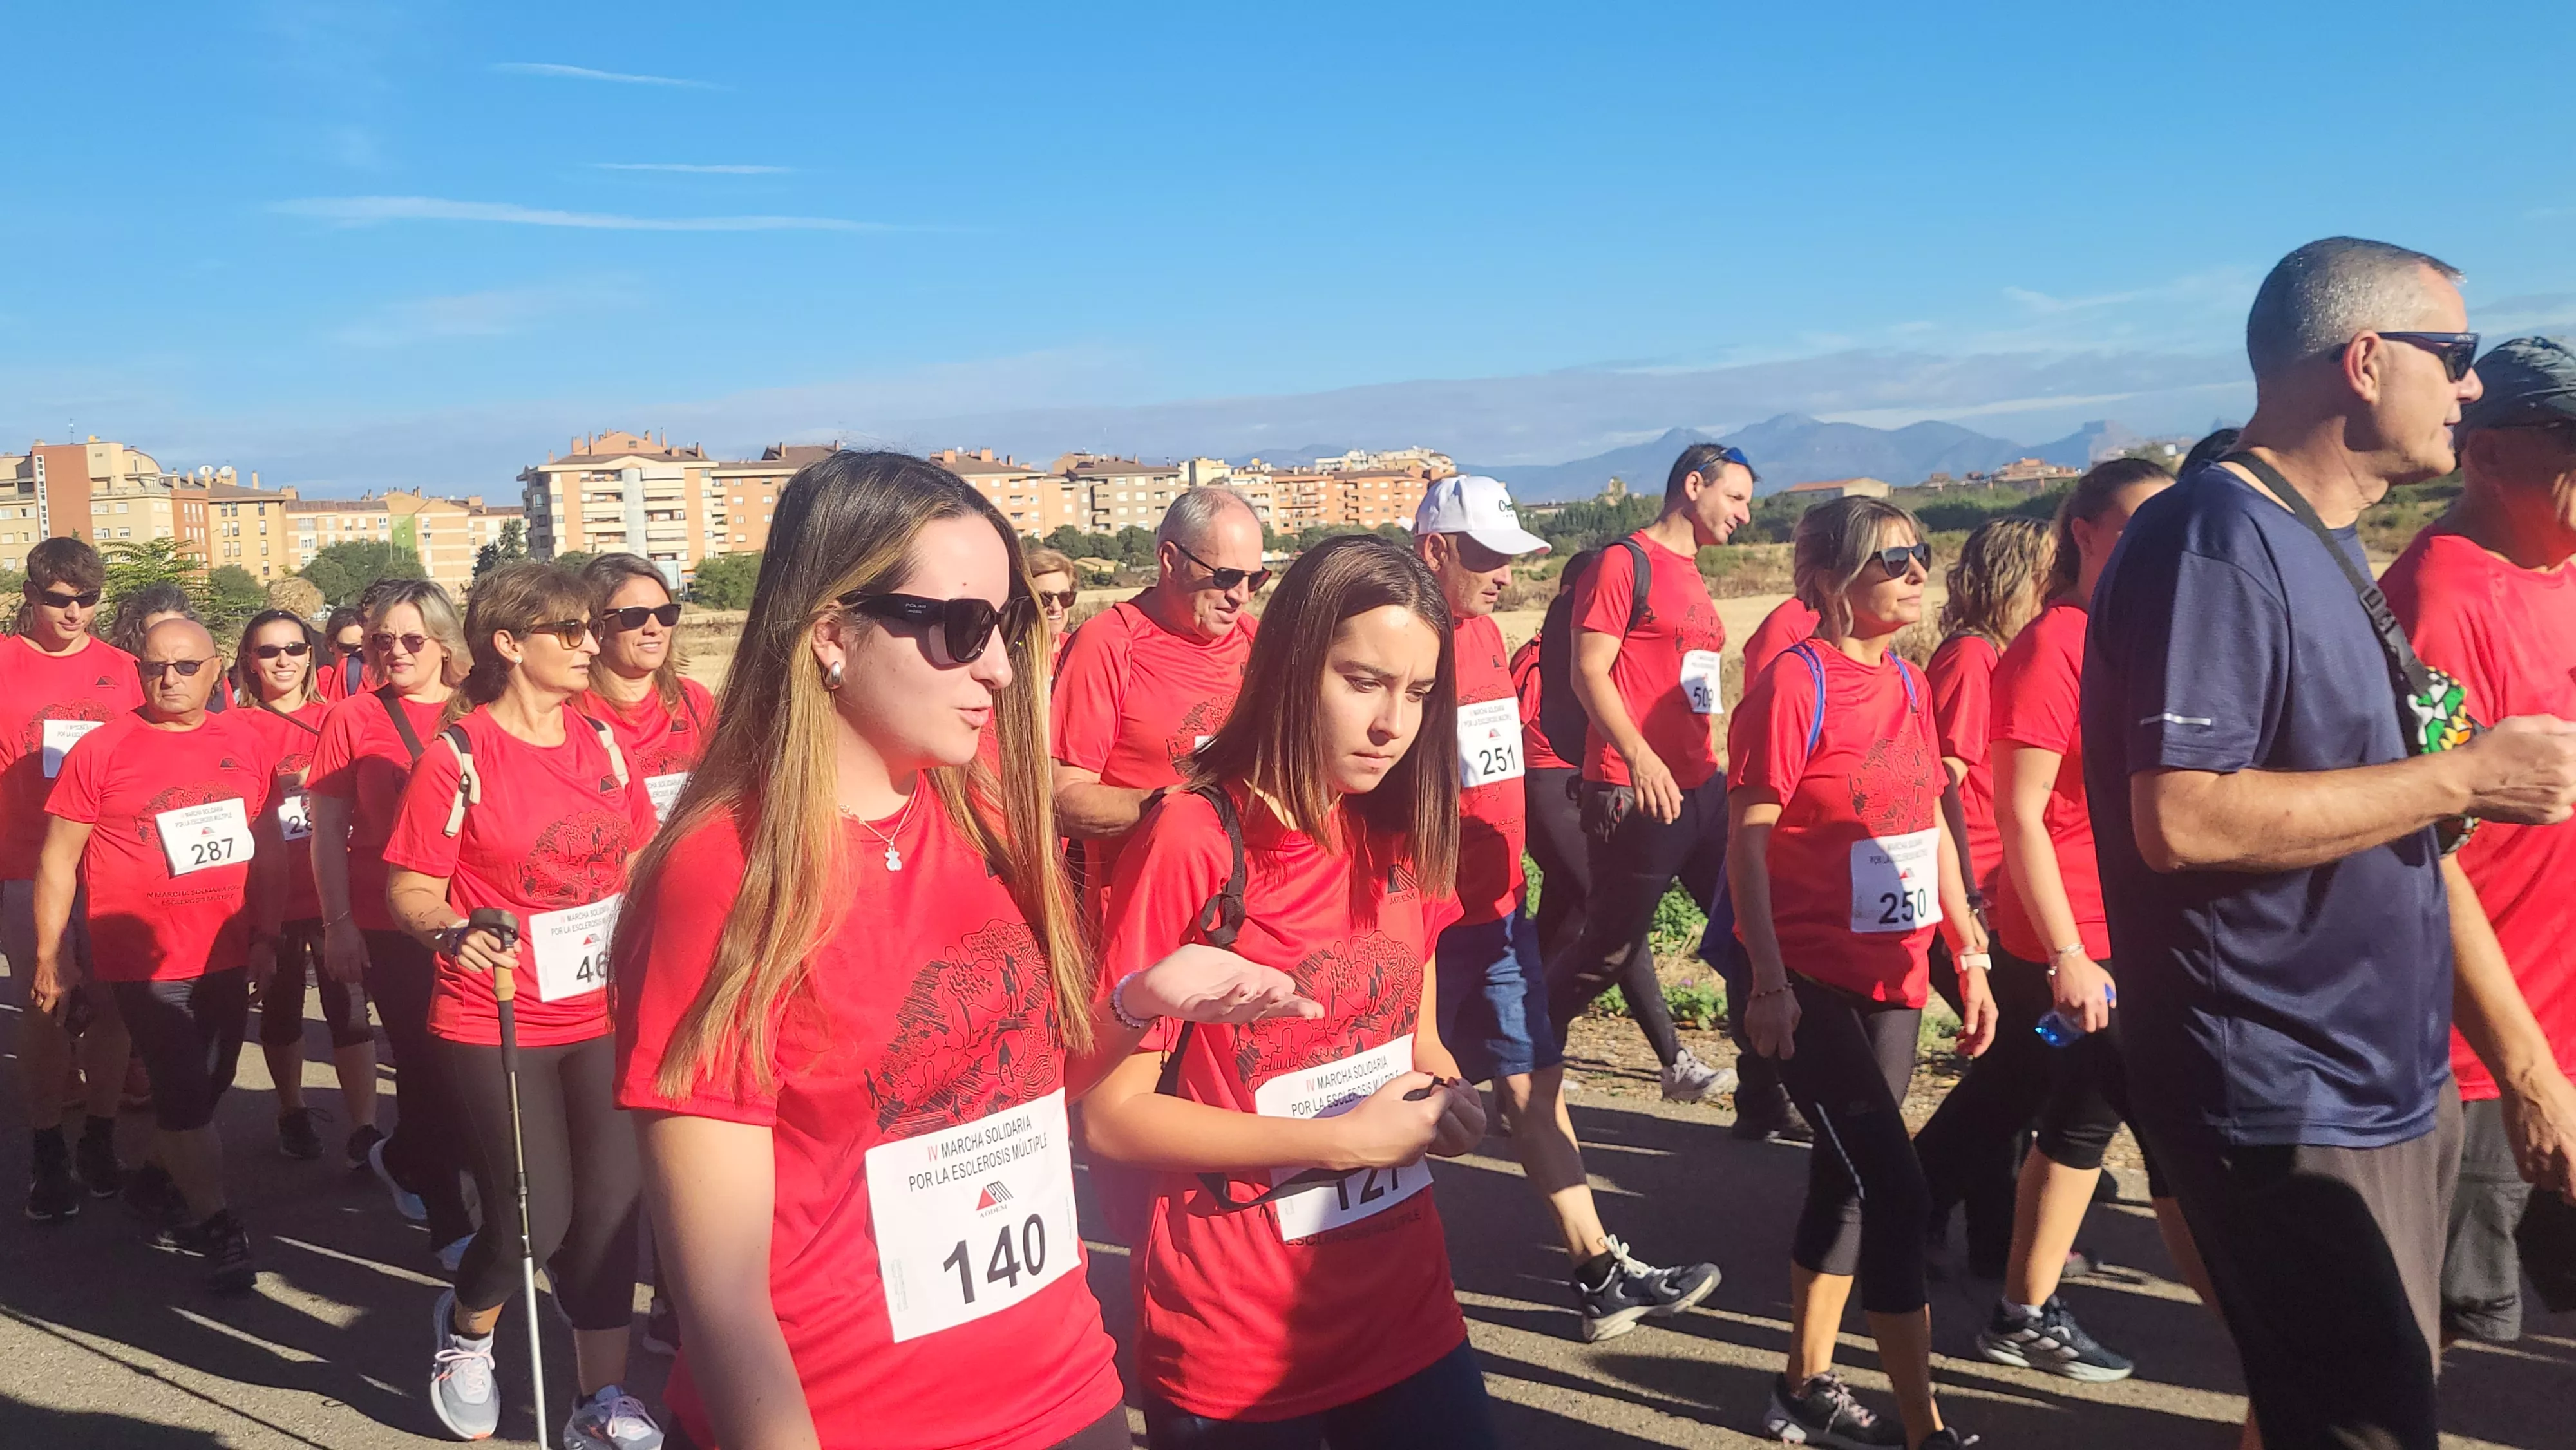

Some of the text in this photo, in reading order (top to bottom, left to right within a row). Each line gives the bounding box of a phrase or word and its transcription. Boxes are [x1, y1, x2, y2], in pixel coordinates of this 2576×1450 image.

[1479, 744, 1515, 775] 251
[191, 837, 233, 865] 287
[1879, 888, 1926, 925] 250
[1306, 1055, 1388, 1093] IV MARCHA SOLIDARIA
[1291, 1100, 1312, 1117] POR
[1312, 1097, 1325, 1112] LA
[1326, 1081, 1372, 1109] ESCLEROSIS
[927, 1115, 1032, 1162] IV MARCHA SOLIDARIA
[909, 1131, 1048, 1193] POR LA ESCLEROSIS MÚLTIPLE
[943, 1212, 1046, 1304] 140
